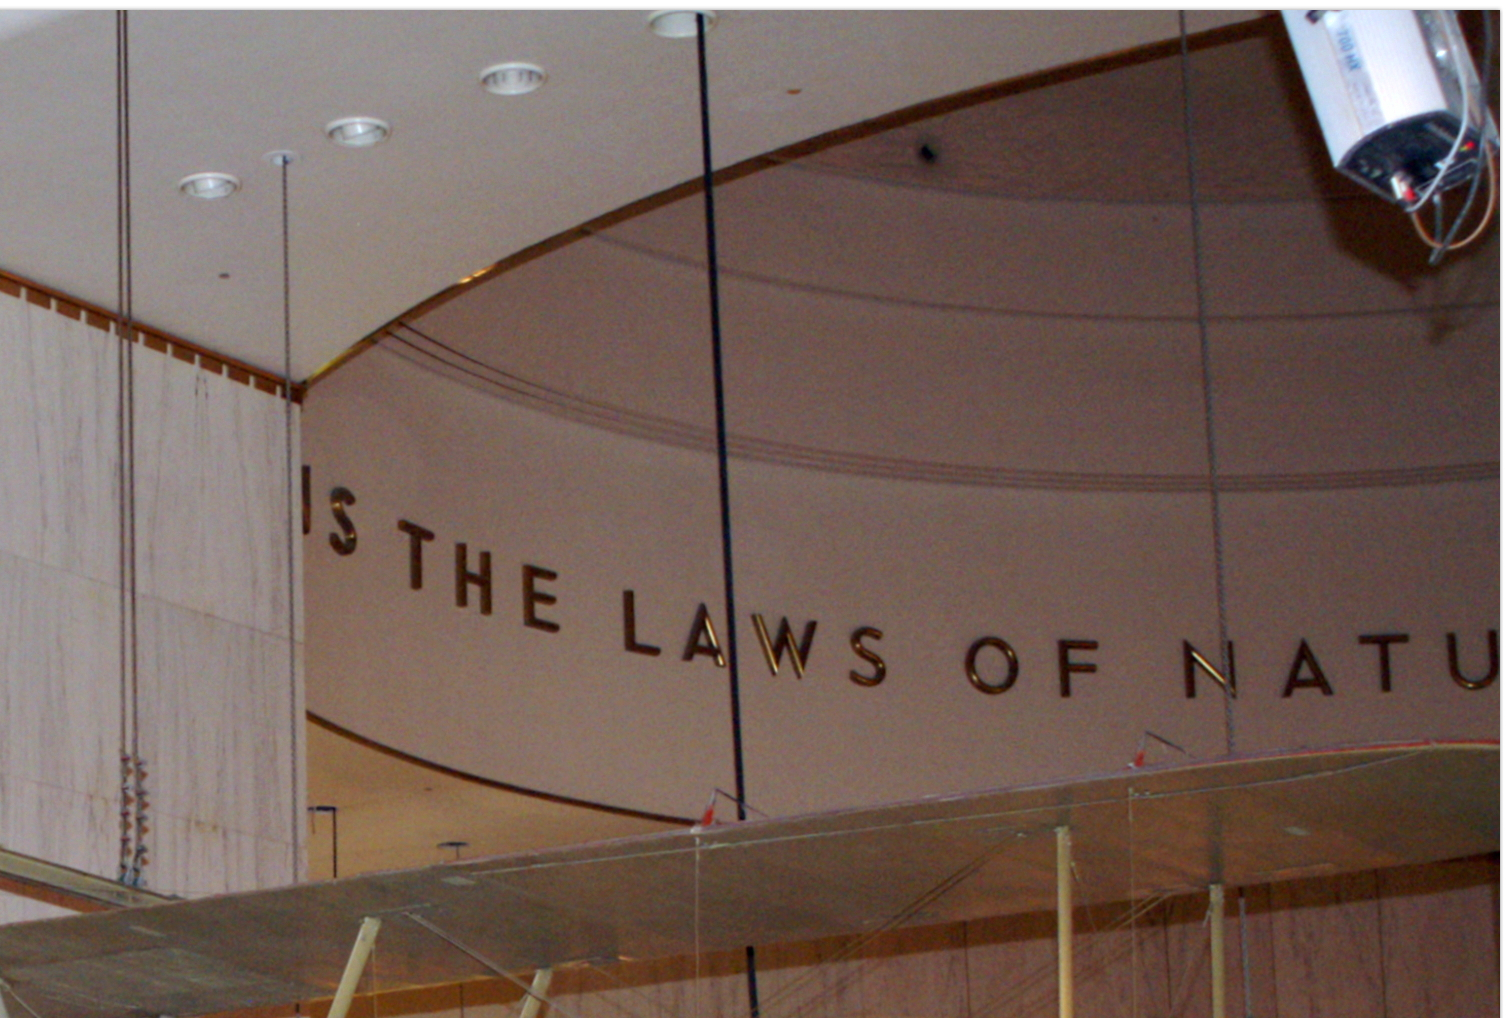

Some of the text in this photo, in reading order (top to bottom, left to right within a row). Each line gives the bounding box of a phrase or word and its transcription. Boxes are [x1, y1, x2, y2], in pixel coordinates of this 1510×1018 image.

[397, 519, 560, 633] THE
[622, 588, 887, 687] LAWS
[964, 636, 1099, 698] OF
[1182, 629, 1499, 699] NATU
